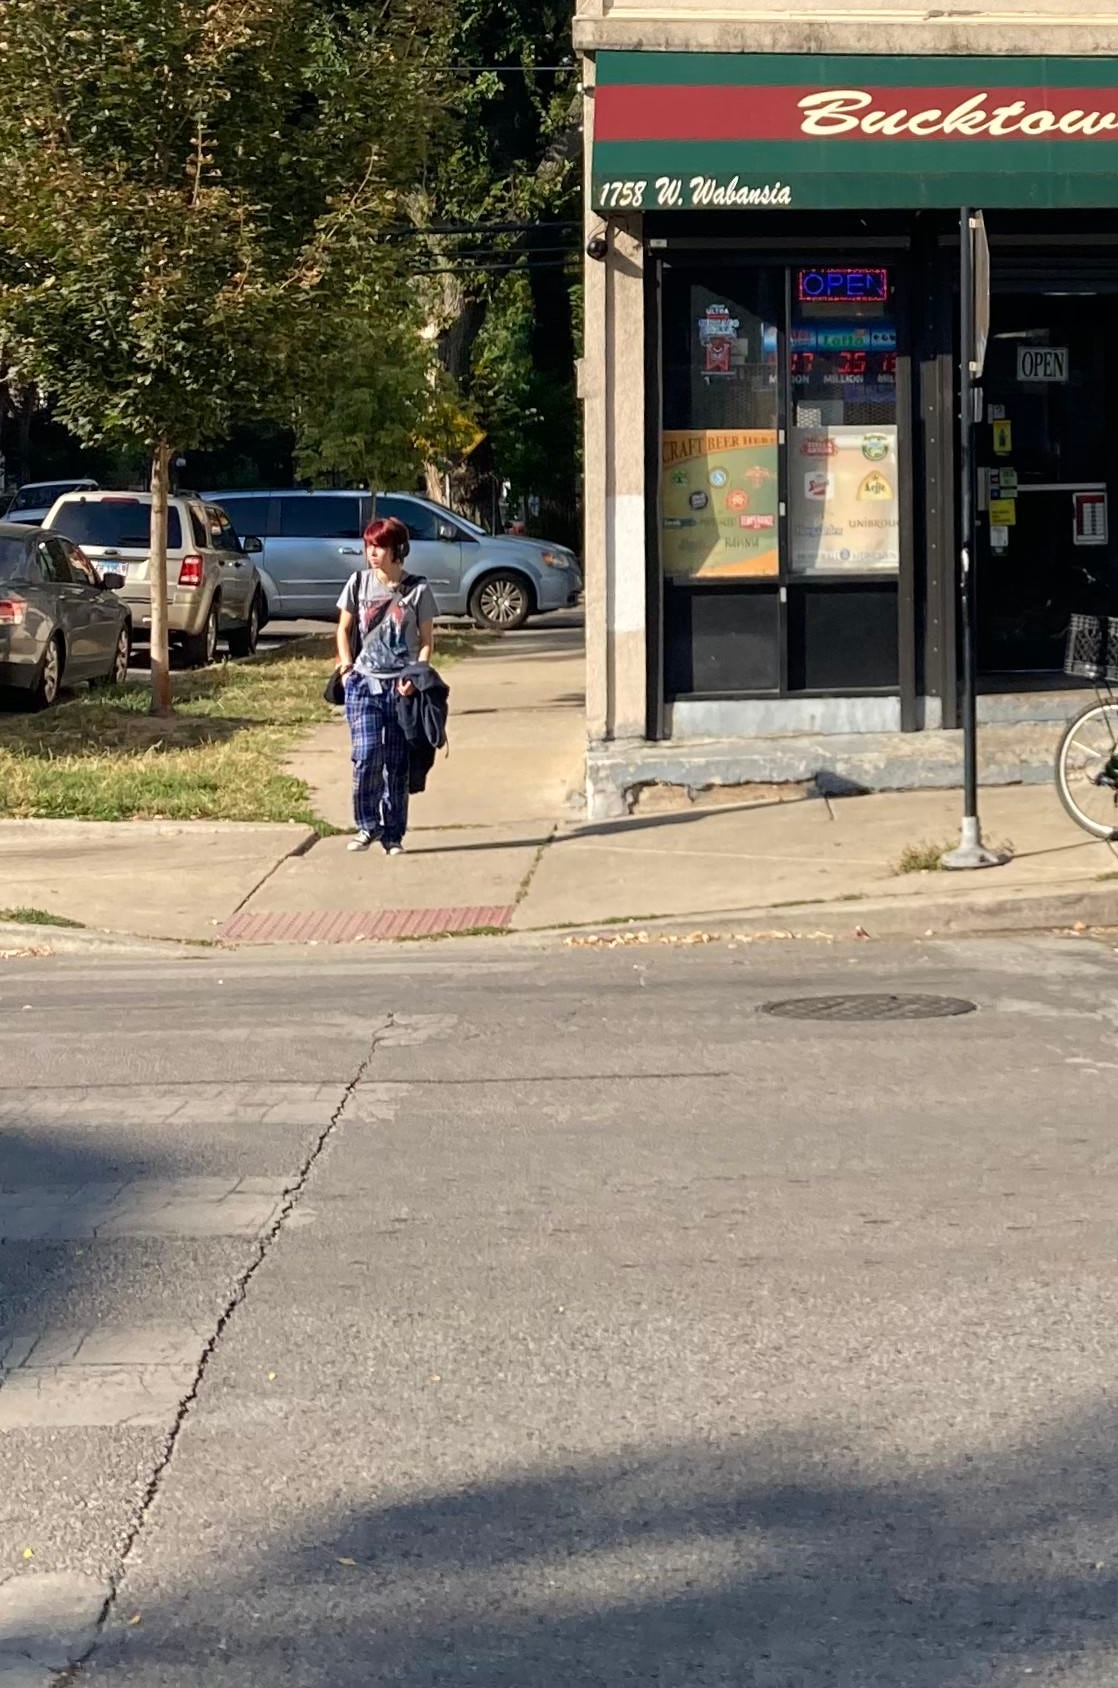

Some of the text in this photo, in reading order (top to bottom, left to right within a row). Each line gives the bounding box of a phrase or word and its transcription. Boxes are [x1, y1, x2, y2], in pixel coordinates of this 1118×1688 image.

[600, 175, 792, 207] 1758 W. Wabansia
[803, 273, 888, 296] OPEN
[1021, 351, 1064, 378] OPEN
[662, 437, 705, 463] CRAFT
[707, 435, 739, 451] BEER
